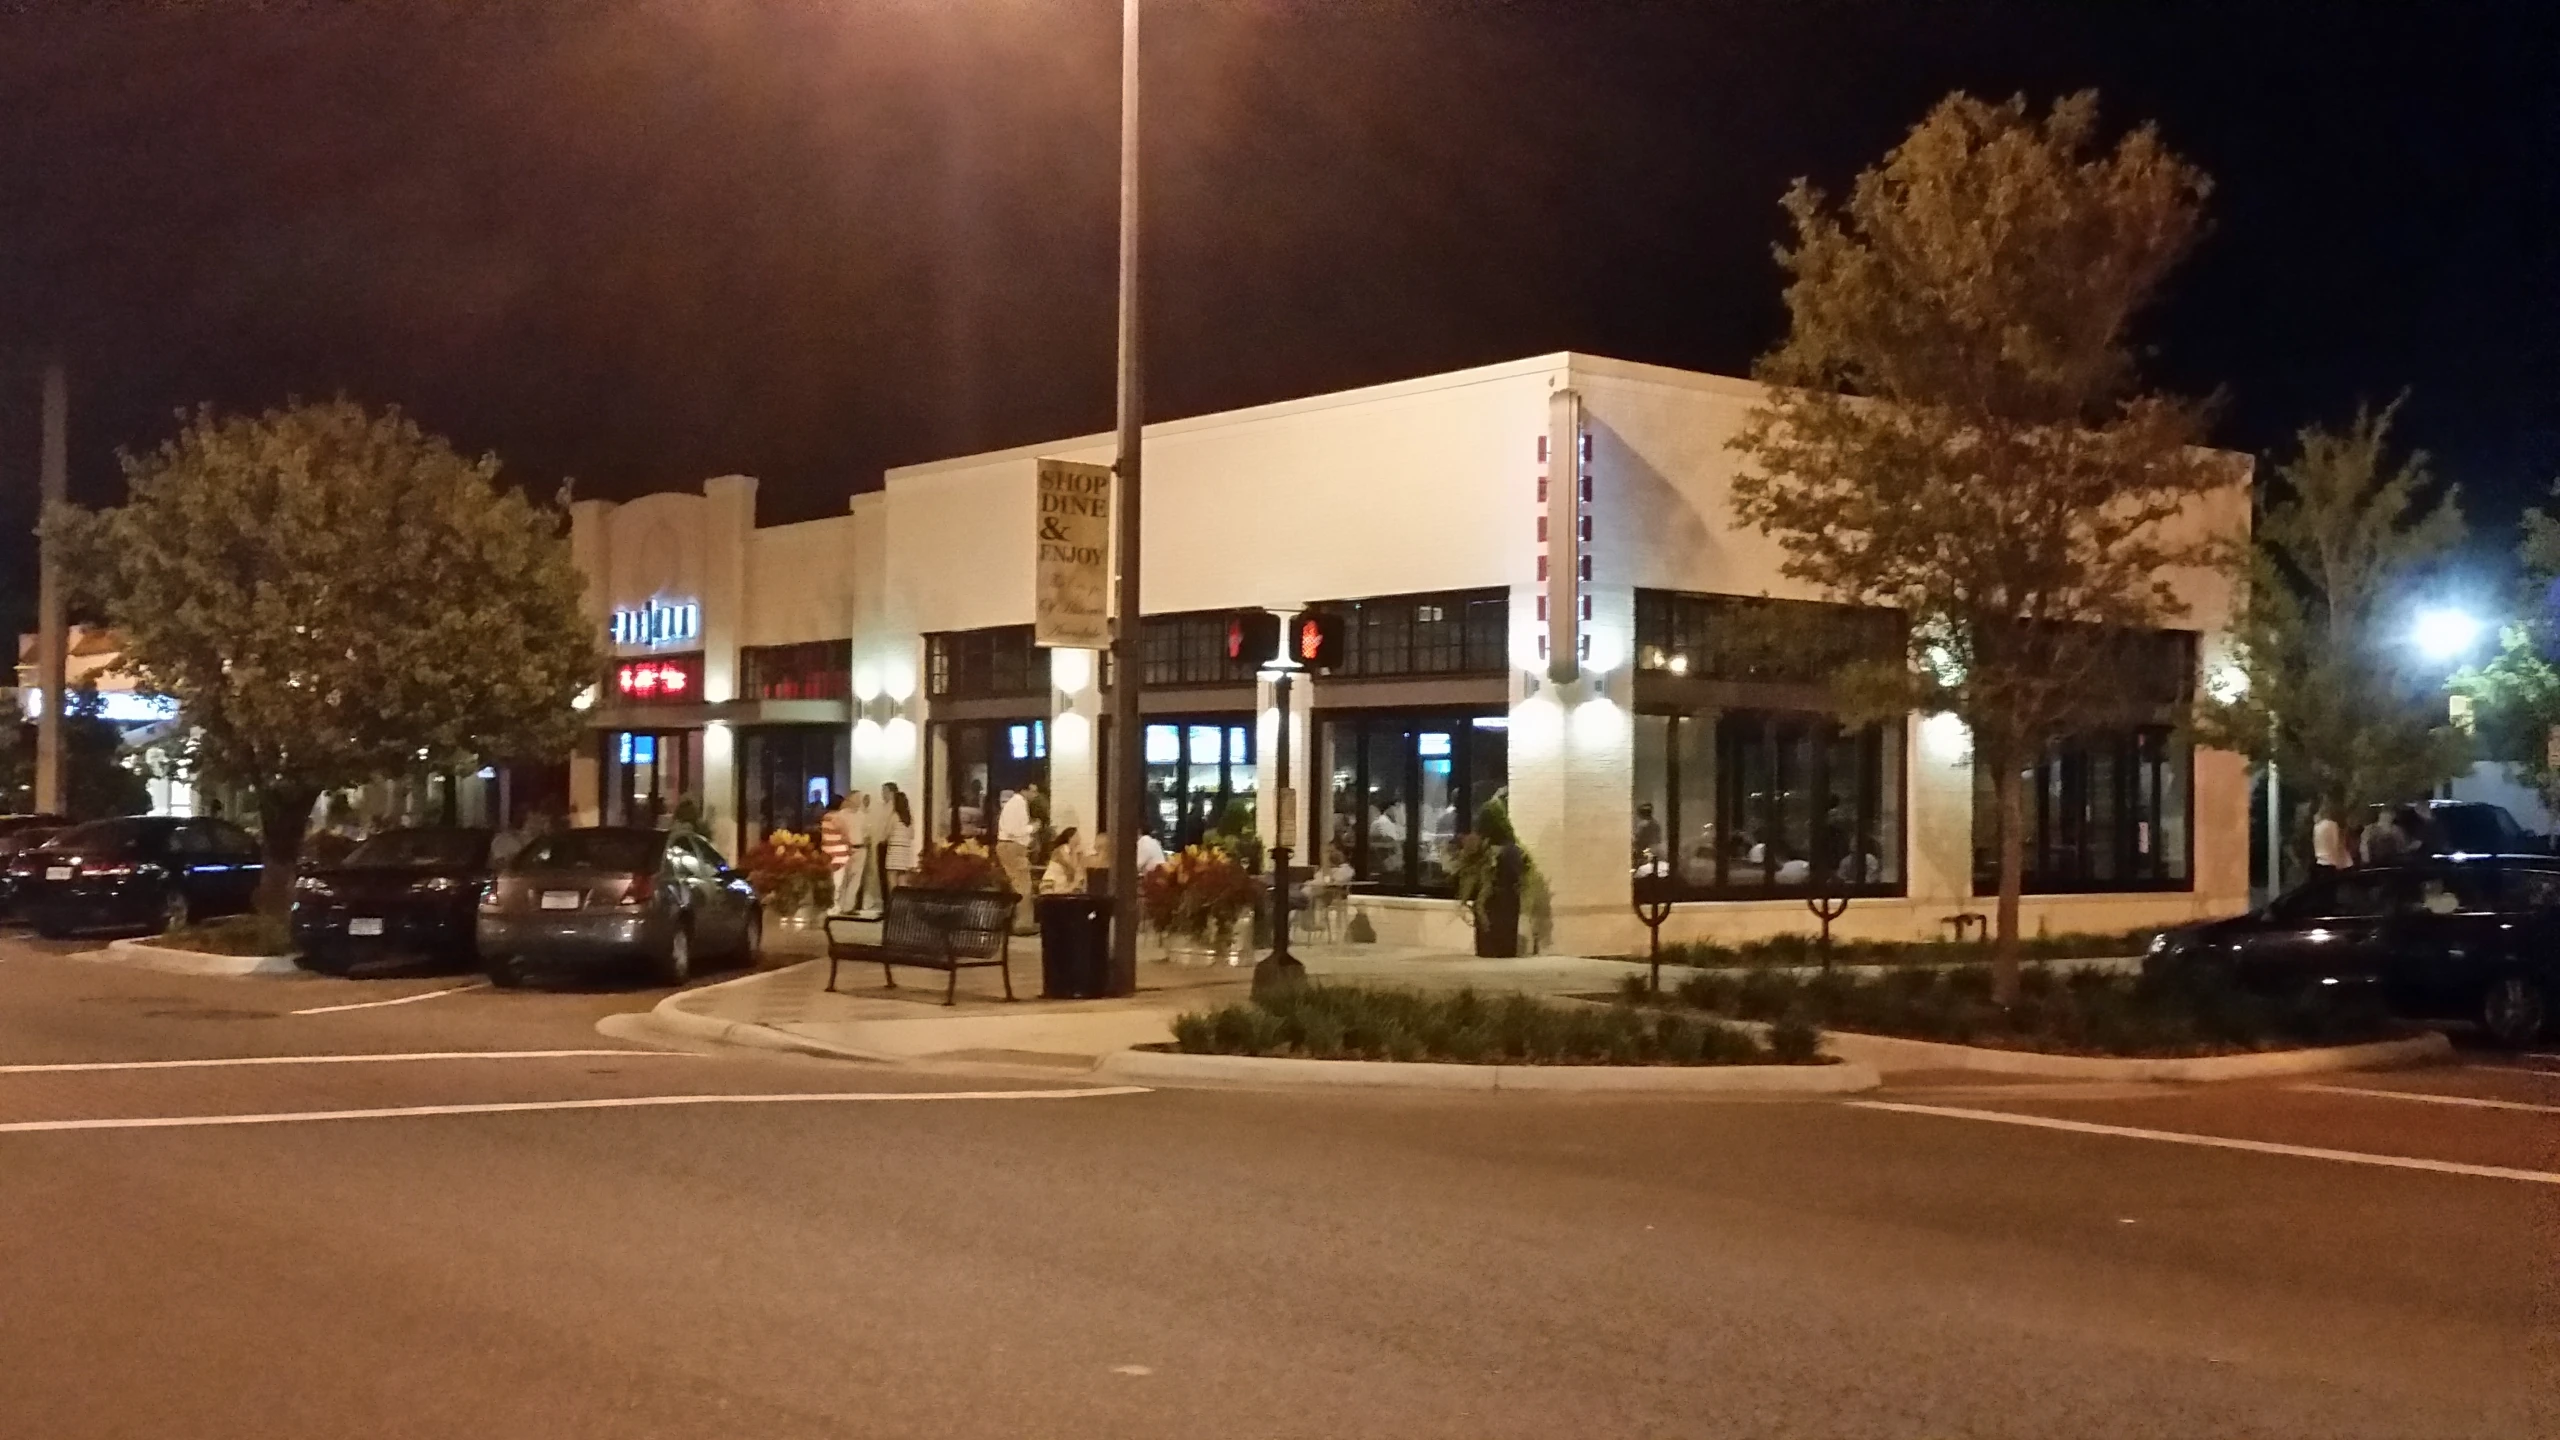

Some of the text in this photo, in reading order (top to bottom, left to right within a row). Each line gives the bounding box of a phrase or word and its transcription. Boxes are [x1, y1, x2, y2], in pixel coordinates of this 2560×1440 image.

[1040, 469, 1108, 494] SHOP
[1042, 492, 1108, 517] DINE
[1040, 516, 1070, 541] &
